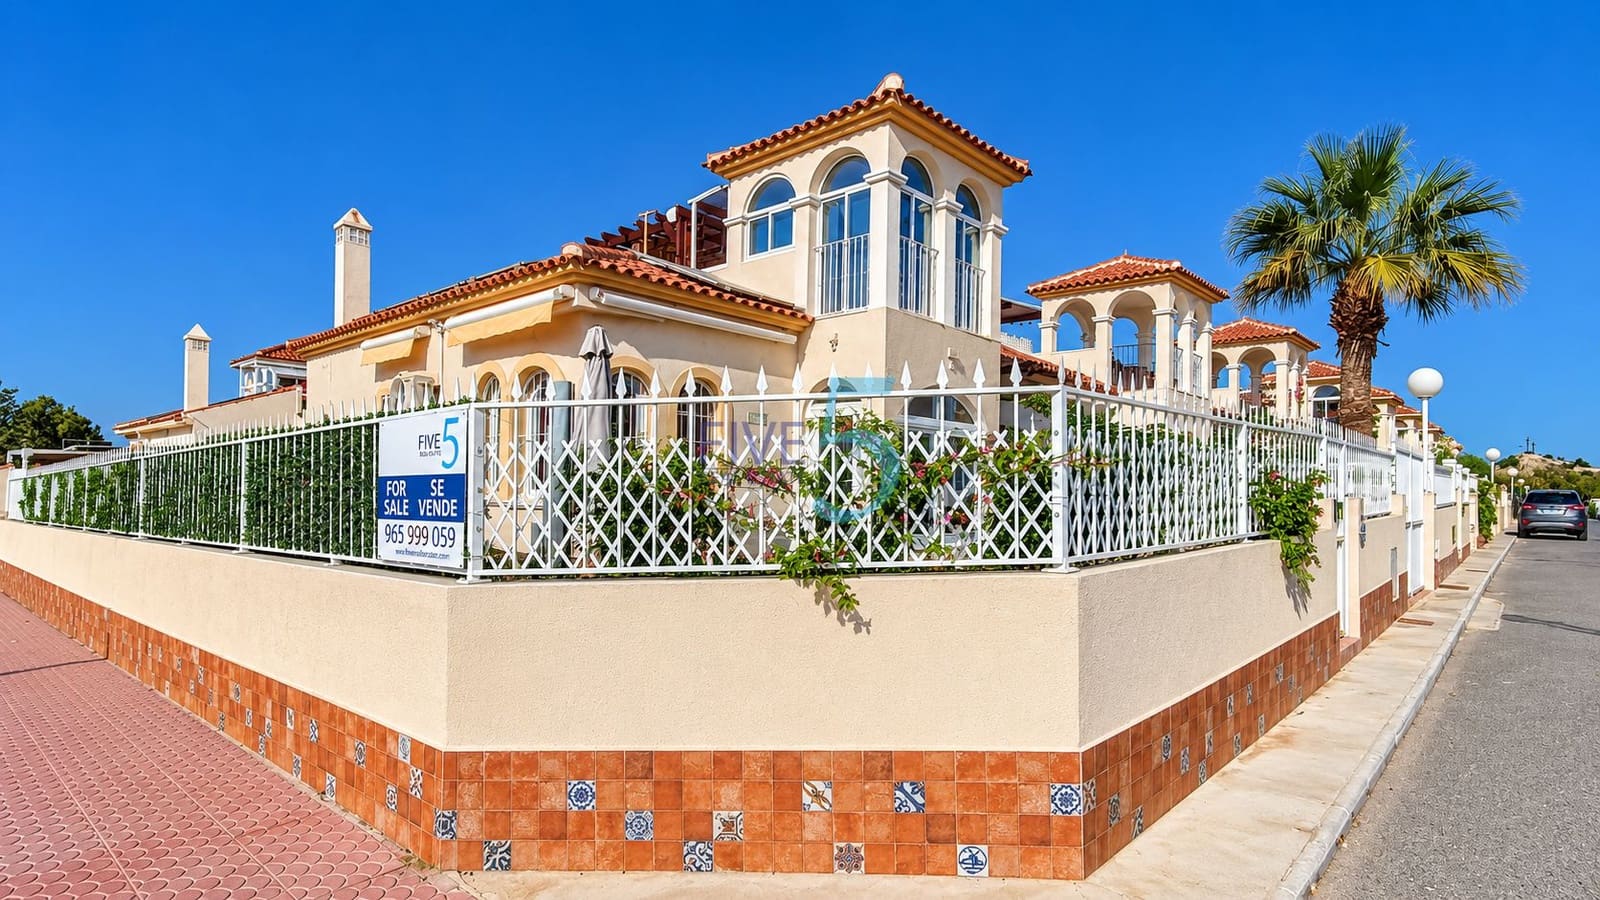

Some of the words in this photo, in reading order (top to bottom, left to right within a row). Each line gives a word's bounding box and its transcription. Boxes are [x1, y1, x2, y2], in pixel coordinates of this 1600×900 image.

[418, 434, 441, 450] FIVE
[441, 417, 459, 469] 5
[386, 480, 407, 497] FOR
[430, 479, 445, 497] SE
[384, 499, 409, 516] SALE
[418, 499, 458, 517] VENDE
[385, 524, 404, 544] 965
[407, 525, 429, 546] 999
[431, 527, 456, 548] 059
